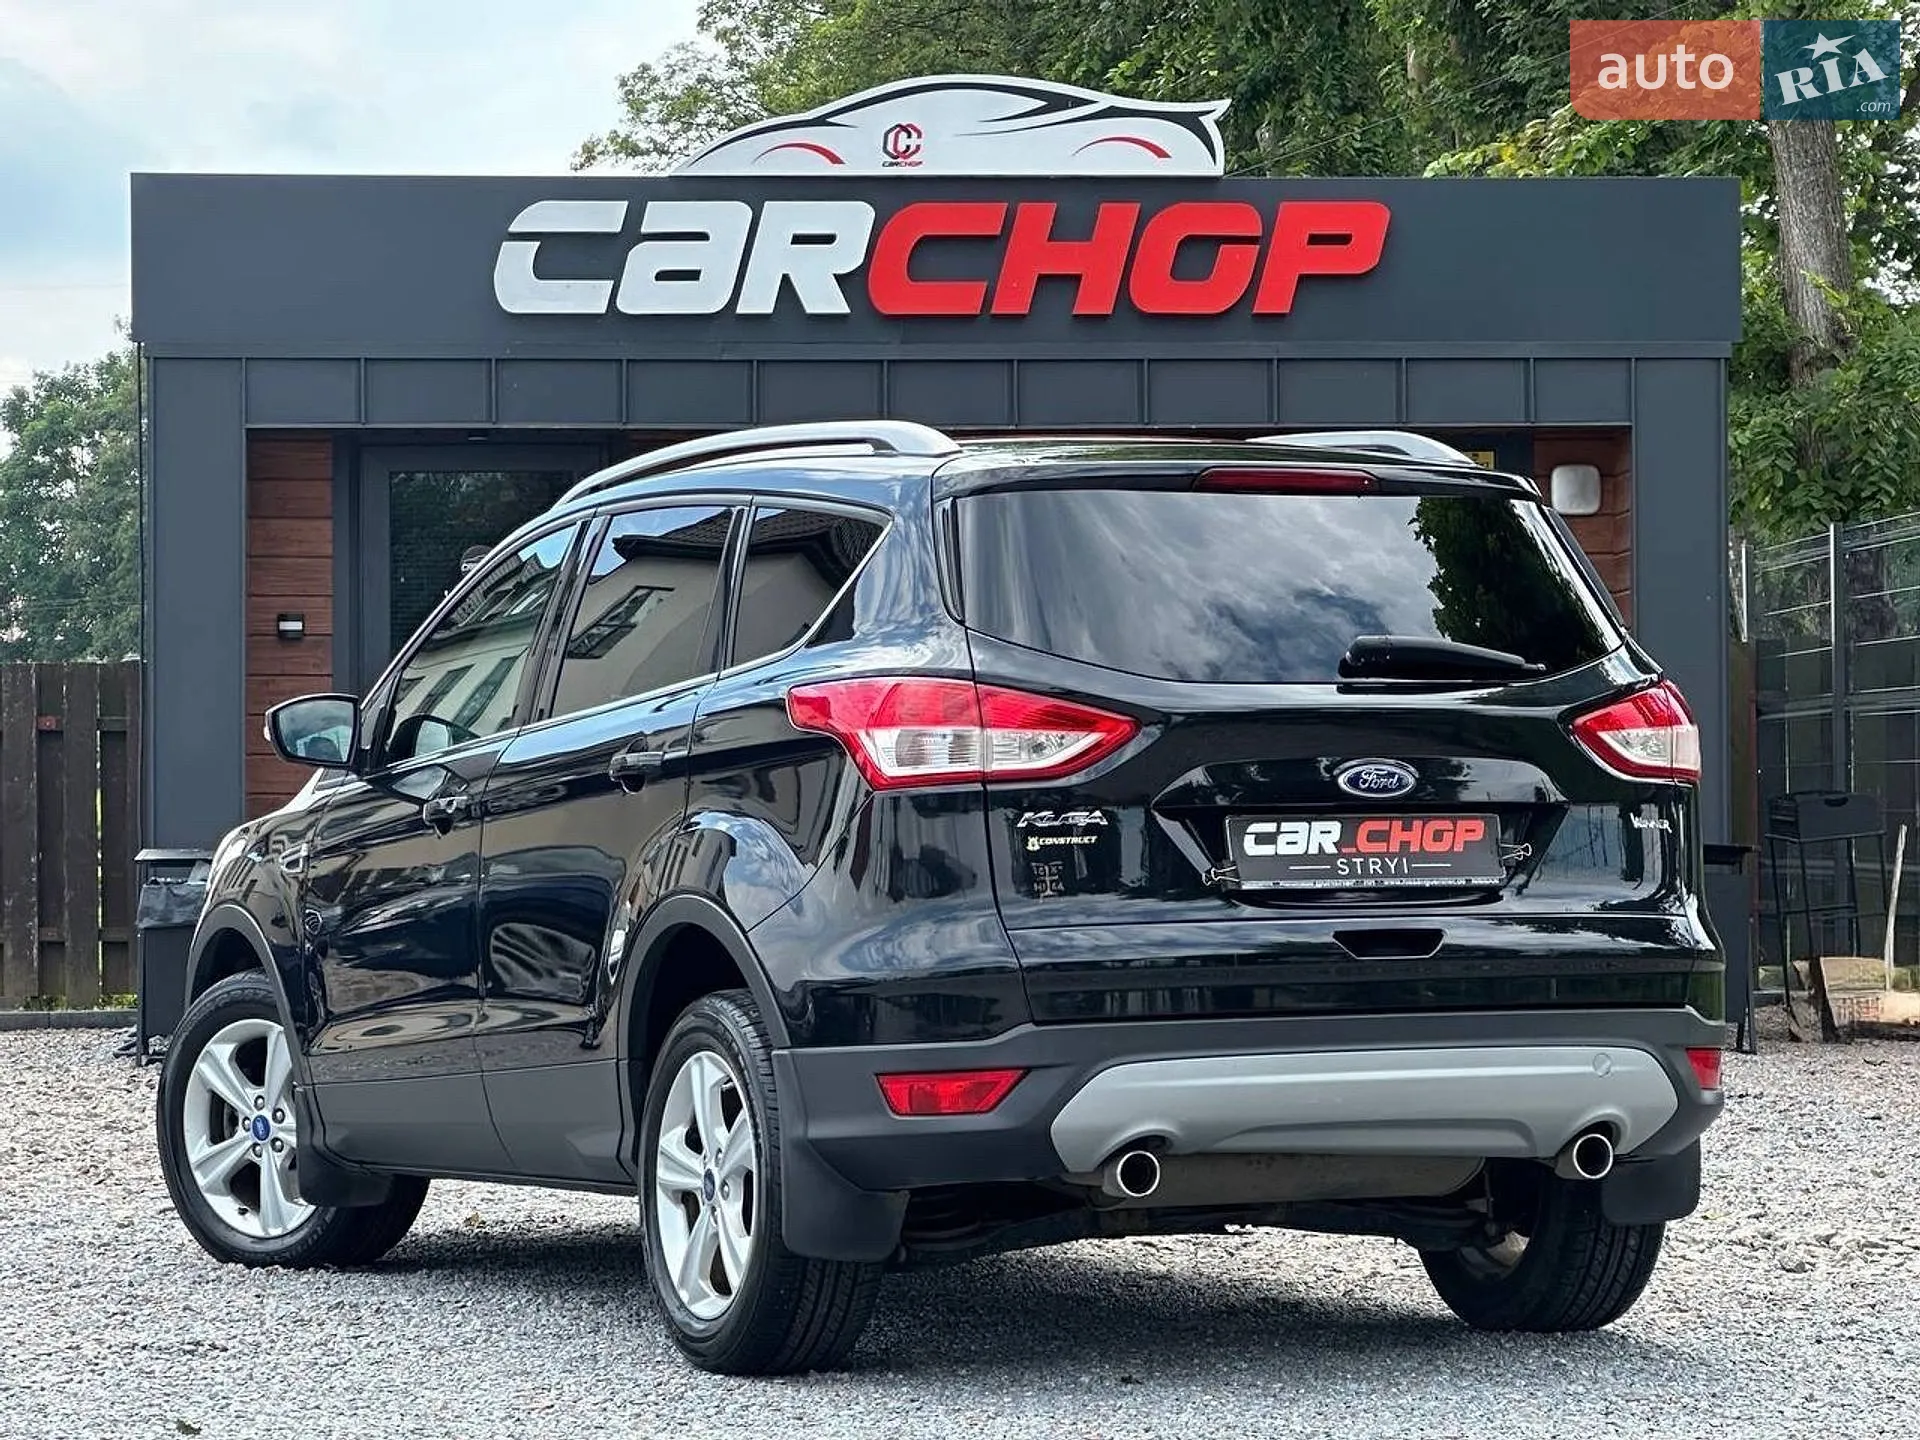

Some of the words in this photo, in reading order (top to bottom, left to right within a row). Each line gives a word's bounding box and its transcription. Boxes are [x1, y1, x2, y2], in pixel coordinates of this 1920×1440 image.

[1358, 767, 1400, 790] Ford
[1016, 809, 1109, 828] KUGA
[1038, 835, 1098, 846] CONSTRUCT
[1336, 857, 1409, 875] STRYI
